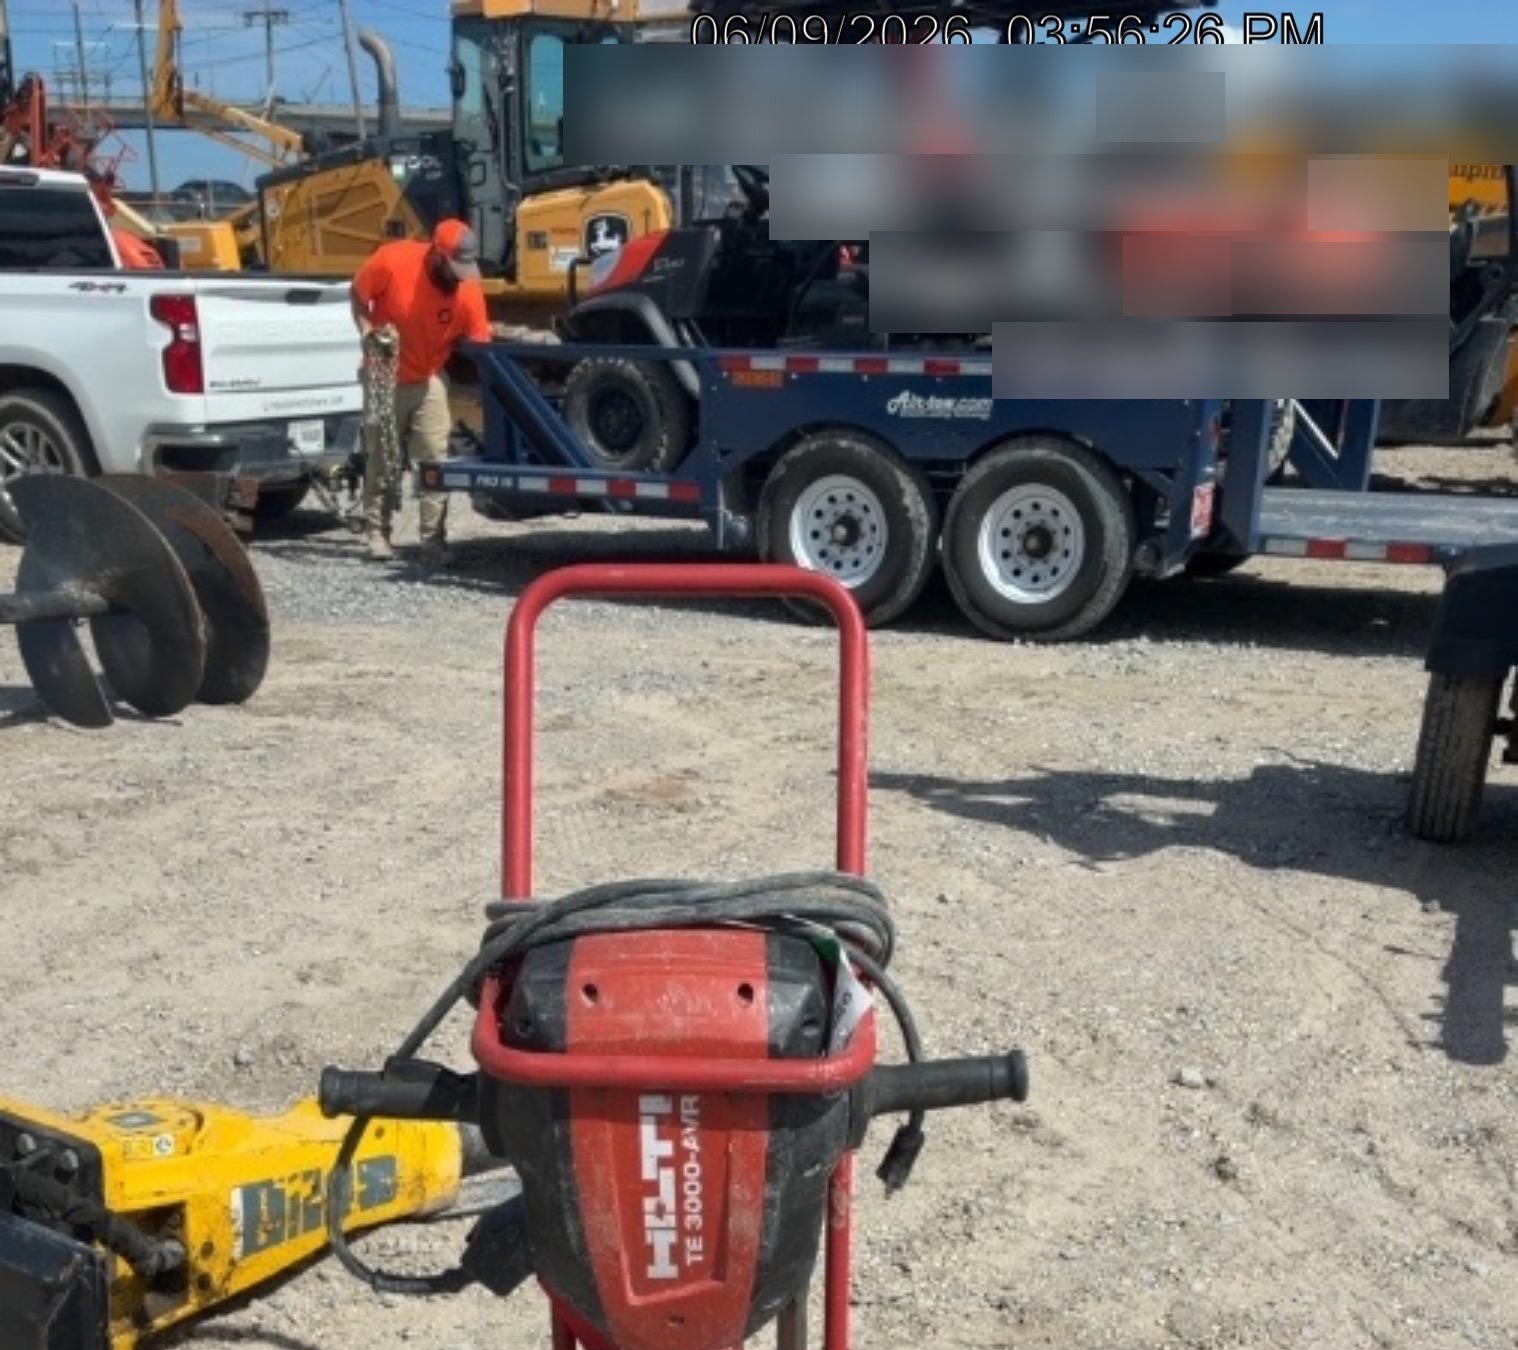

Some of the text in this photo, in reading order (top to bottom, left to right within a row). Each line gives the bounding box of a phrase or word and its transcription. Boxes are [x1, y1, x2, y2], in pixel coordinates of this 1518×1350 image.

[638, 1094, 679, 1279] HILTI
[680, 1095, 704, 1267] TE 3000-AVR
